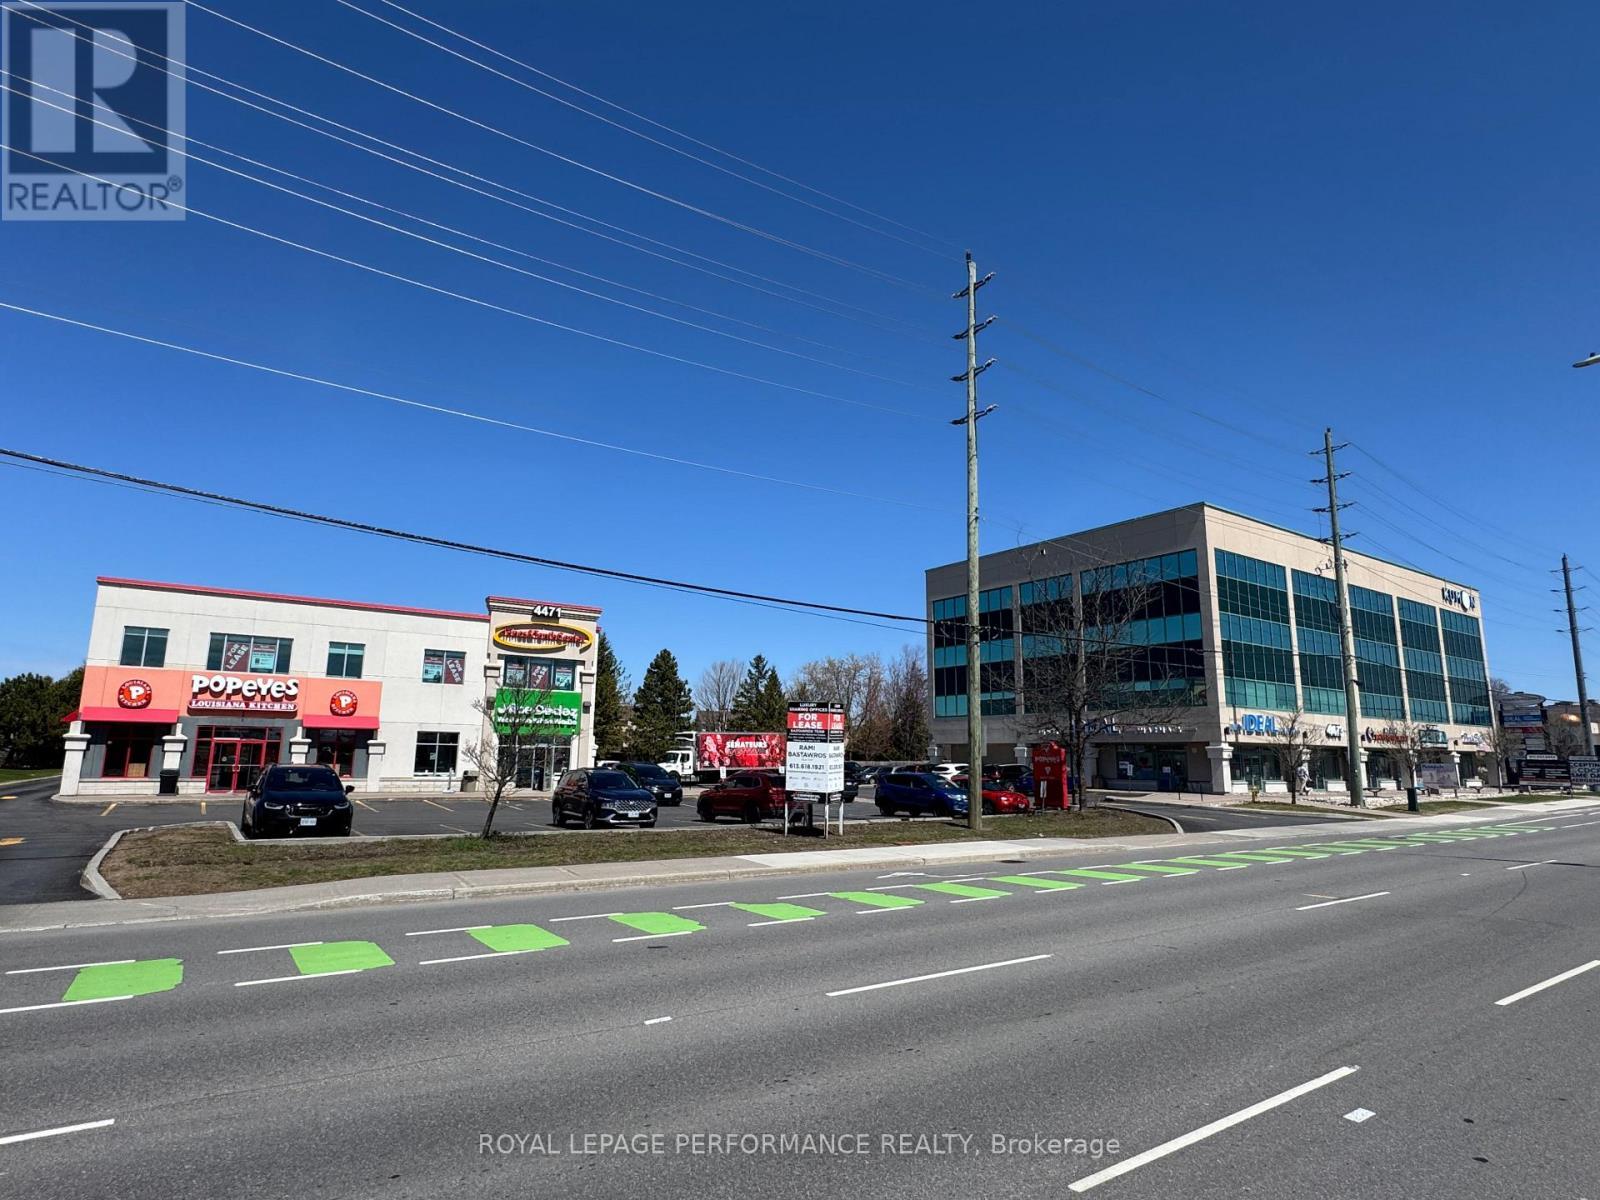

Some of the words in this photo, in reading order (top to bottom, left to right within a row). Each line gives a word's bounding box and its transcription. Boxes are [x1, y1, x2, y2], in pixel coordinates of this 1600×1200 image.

[533, 605, 561, 617] 4471
[225, 644, 249, 669] LEASE
[227, 643, 240, 657] FOR
[129, 685, 145, 700] P
[191, 700, 246, 709] LOUISIANA
[249, 702, 295, 710] KITCHEN
[339, 695, 352, 708] P
[798, 713, 817, 721] FOR
[792, 721, 823, 729] LEASE
[1242, 714, 1279, 734] IDEAL
